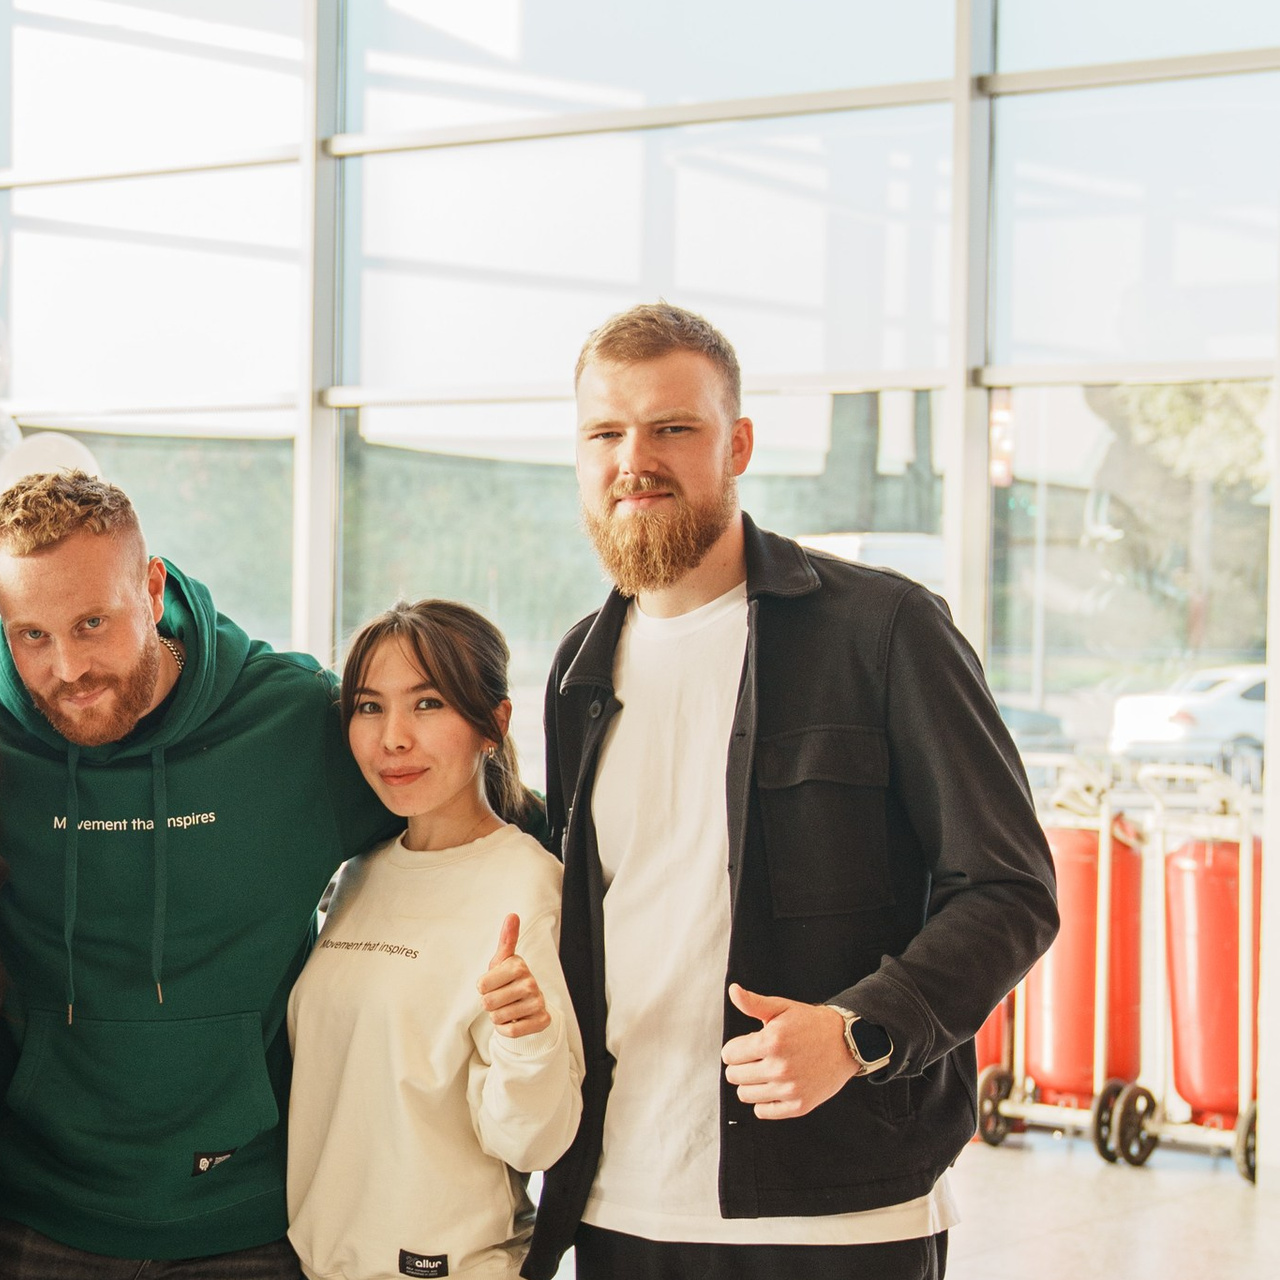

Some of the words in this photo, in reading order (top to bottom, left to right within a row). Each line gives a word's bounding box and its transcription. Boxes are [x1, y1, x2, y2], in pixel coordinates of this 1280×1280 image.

[53, 816, 128, 831] Mvement
[131, 818, 154, 830] tha
[167, 811, 216, 830] nspires
[321, 939, 363, 950] Movement
[363, 940, 380, 952] that
[380, 941, 419, 959] inspires
[415, 1259, 442, 1269] allur
